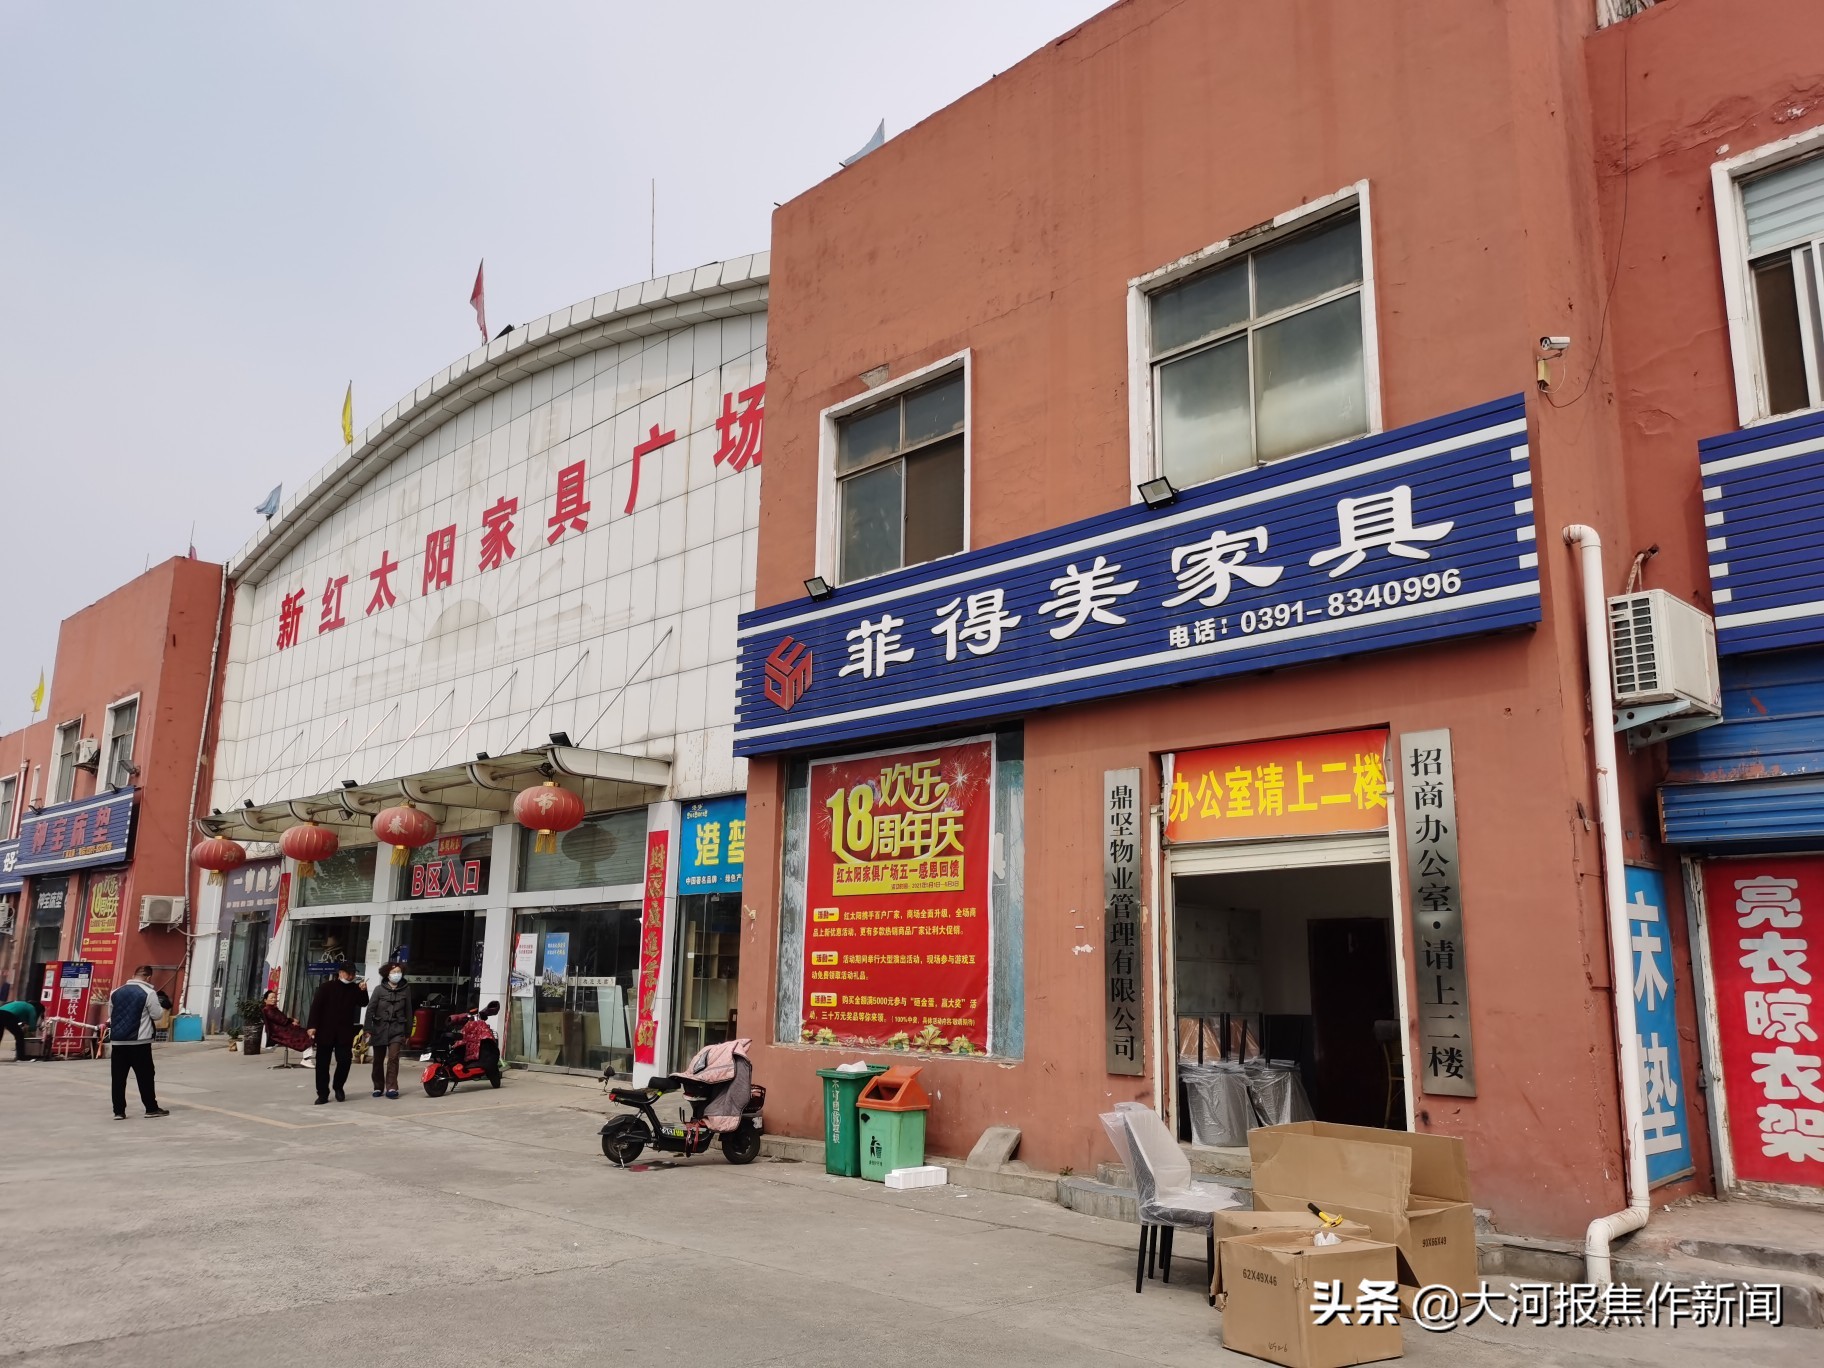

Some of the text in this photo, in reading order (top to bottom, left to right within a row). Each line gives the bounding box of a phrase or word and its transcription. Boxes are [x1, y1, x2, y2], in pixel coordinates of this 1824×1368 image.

[276, 381, 764, 651] 新红太阳家具广场
[838, 485, 1454, 679] 菲得美家具
[879, 758, 950, 811] 欢乐
[1169, 752, 1387, 822] 办公室请上二楼
[411, 859, 480, 898] B区入口
[836, 860, 960, 883] 红太阳家俱广场五一感恩回馈
[1109, 785, 1136, 1062] 鼎坚物业管理有限公司
[1734, 876, 1824, 1162] 亮衣晾衣架
[1242, 1268, 1278, 1287] 62X49X46
